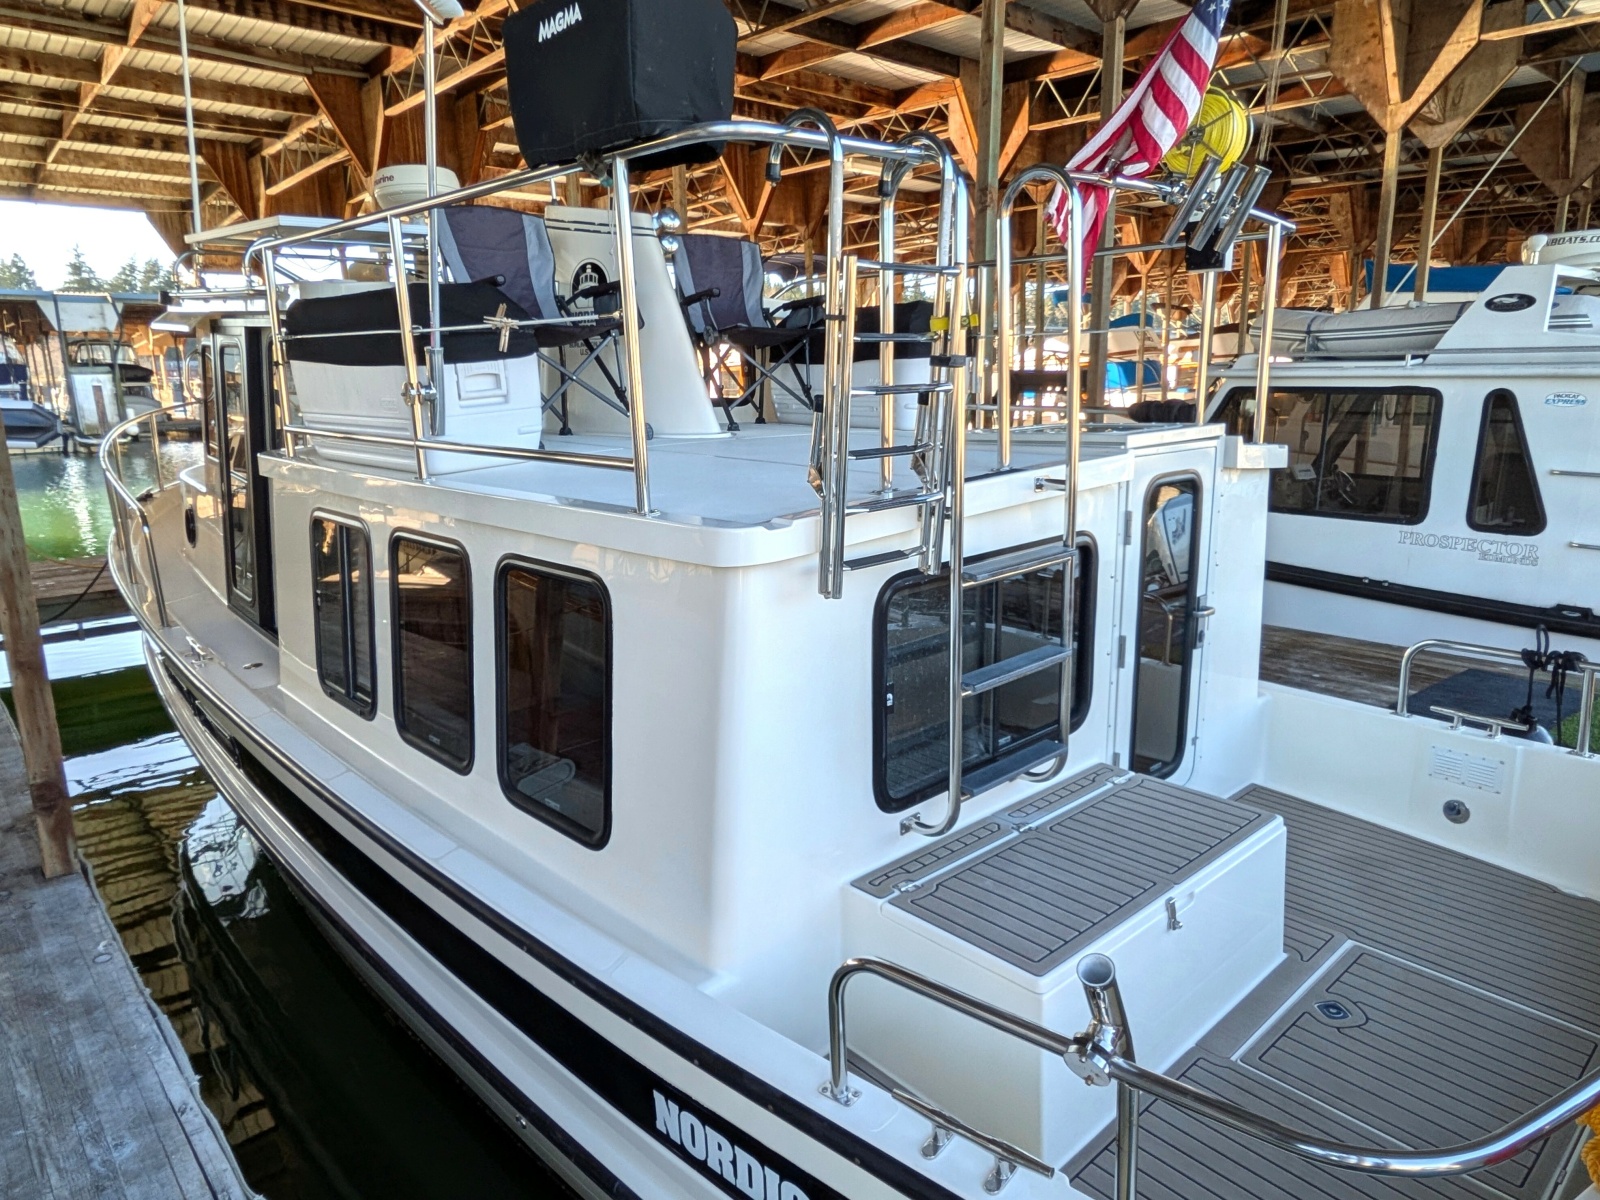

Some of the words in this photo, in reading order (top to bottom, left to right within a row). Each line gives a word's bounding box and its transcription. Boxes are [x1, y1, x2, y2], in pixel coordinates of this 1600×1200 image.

[538, 2, 582, 42] MAGMA
[1398, 530, 1540, 560] PROSPECTOR
[1478, 552, 1539, 567] EDMONDS
